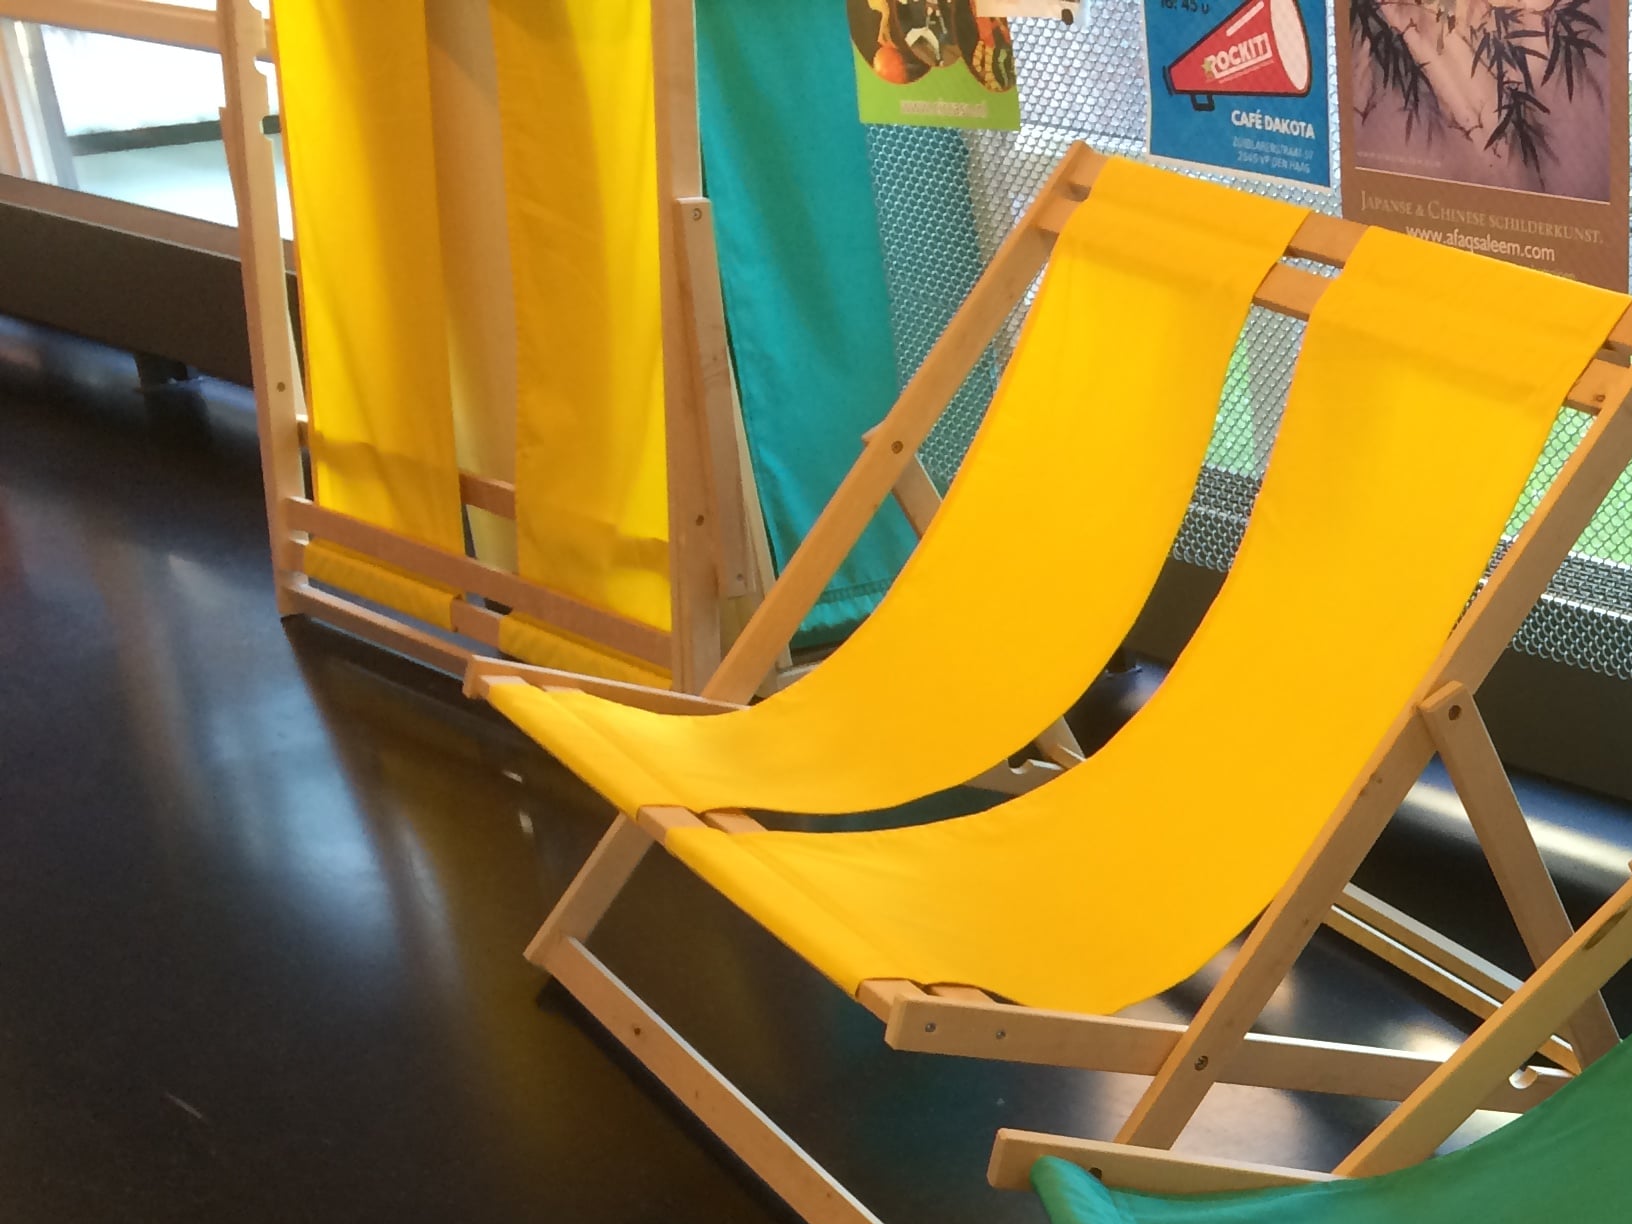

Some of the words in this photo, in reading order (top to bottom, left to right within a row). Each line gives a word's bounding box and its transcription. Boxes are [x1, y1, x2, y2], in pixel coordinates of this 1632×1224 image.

[1206, 36, 1270, 74] ROCKIT
[1231, 109, 1263, 129] CAFÉ
[1264, 117, 1316, 139] DAKOTA
[1415, 203, 1425, 217] &
[1405, 226, 1555, 261] www.afaqsaleem.com
